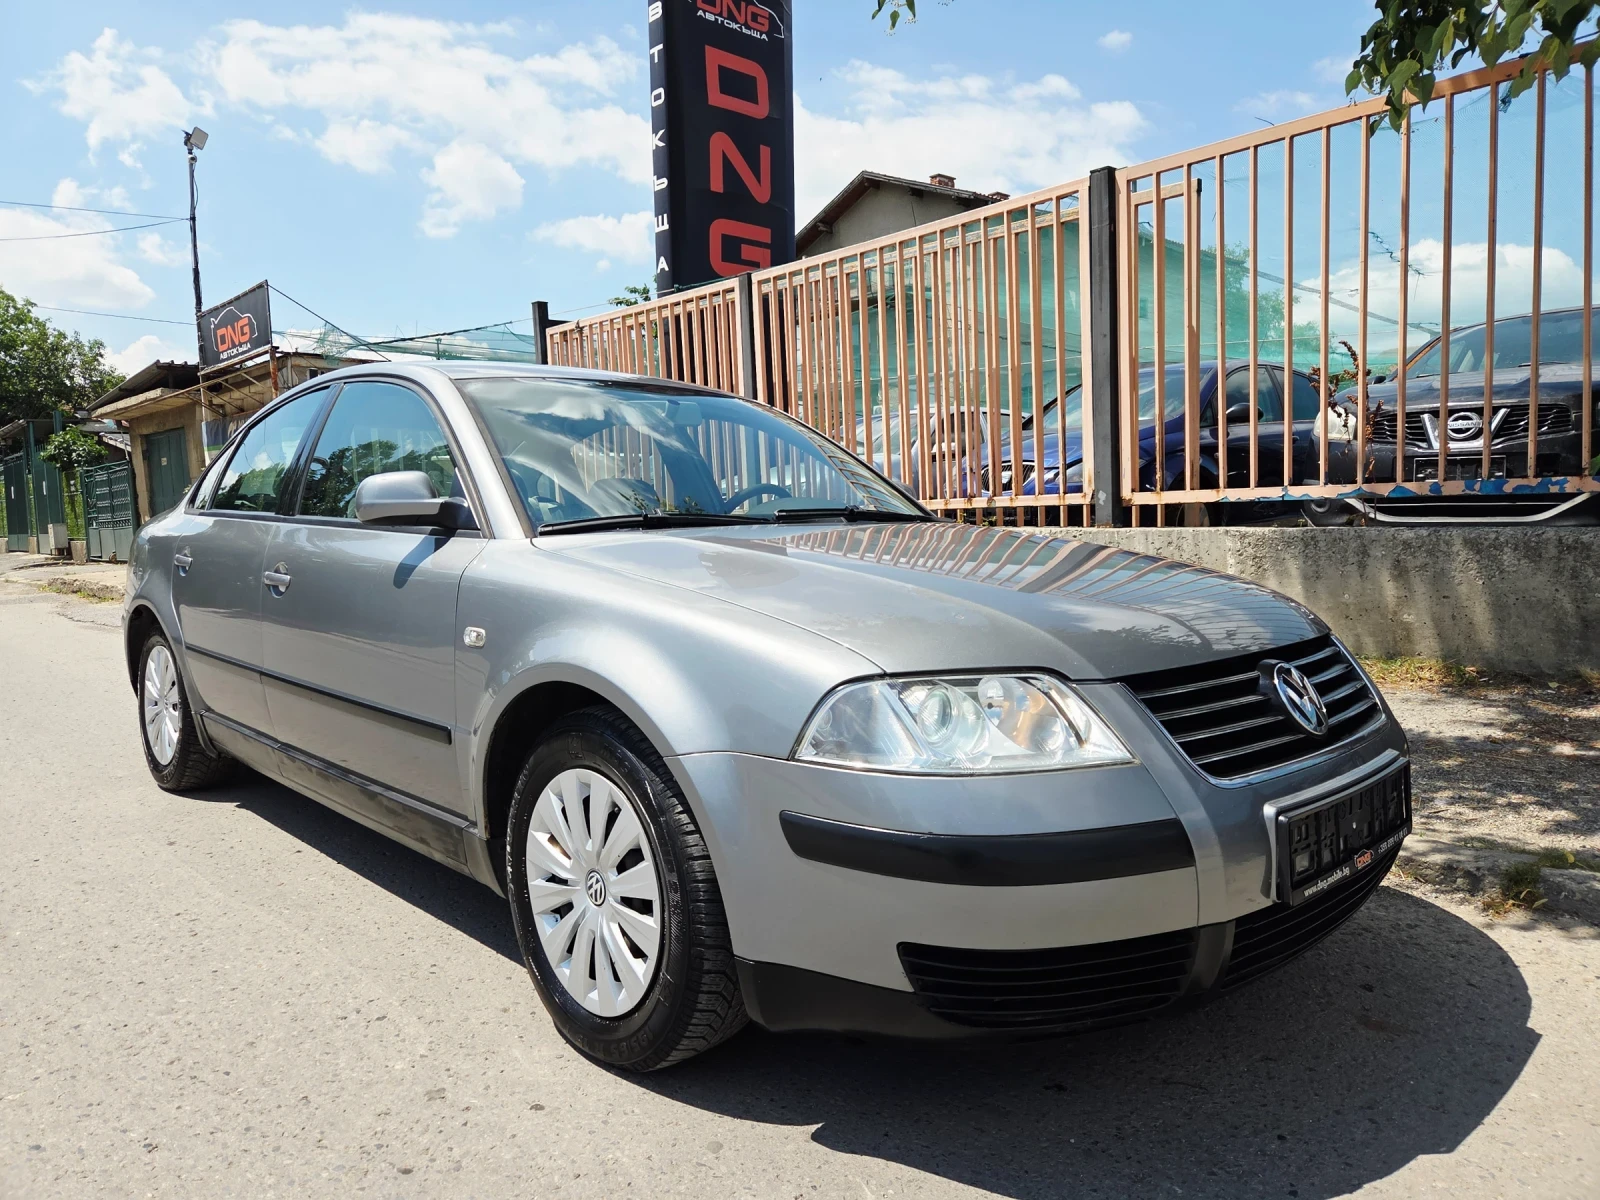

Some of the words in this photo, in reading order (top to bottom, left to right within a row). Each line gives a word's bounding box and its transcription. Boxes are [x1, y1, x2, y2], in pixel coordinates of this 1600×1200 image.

[697, 10, 768, 41] АВТОКЪЩА
[705, 44, 771, 278] DNG
[216, 317, 250, 352] DNG
[220, 342, 251, 360] АВТОКЪЩА
